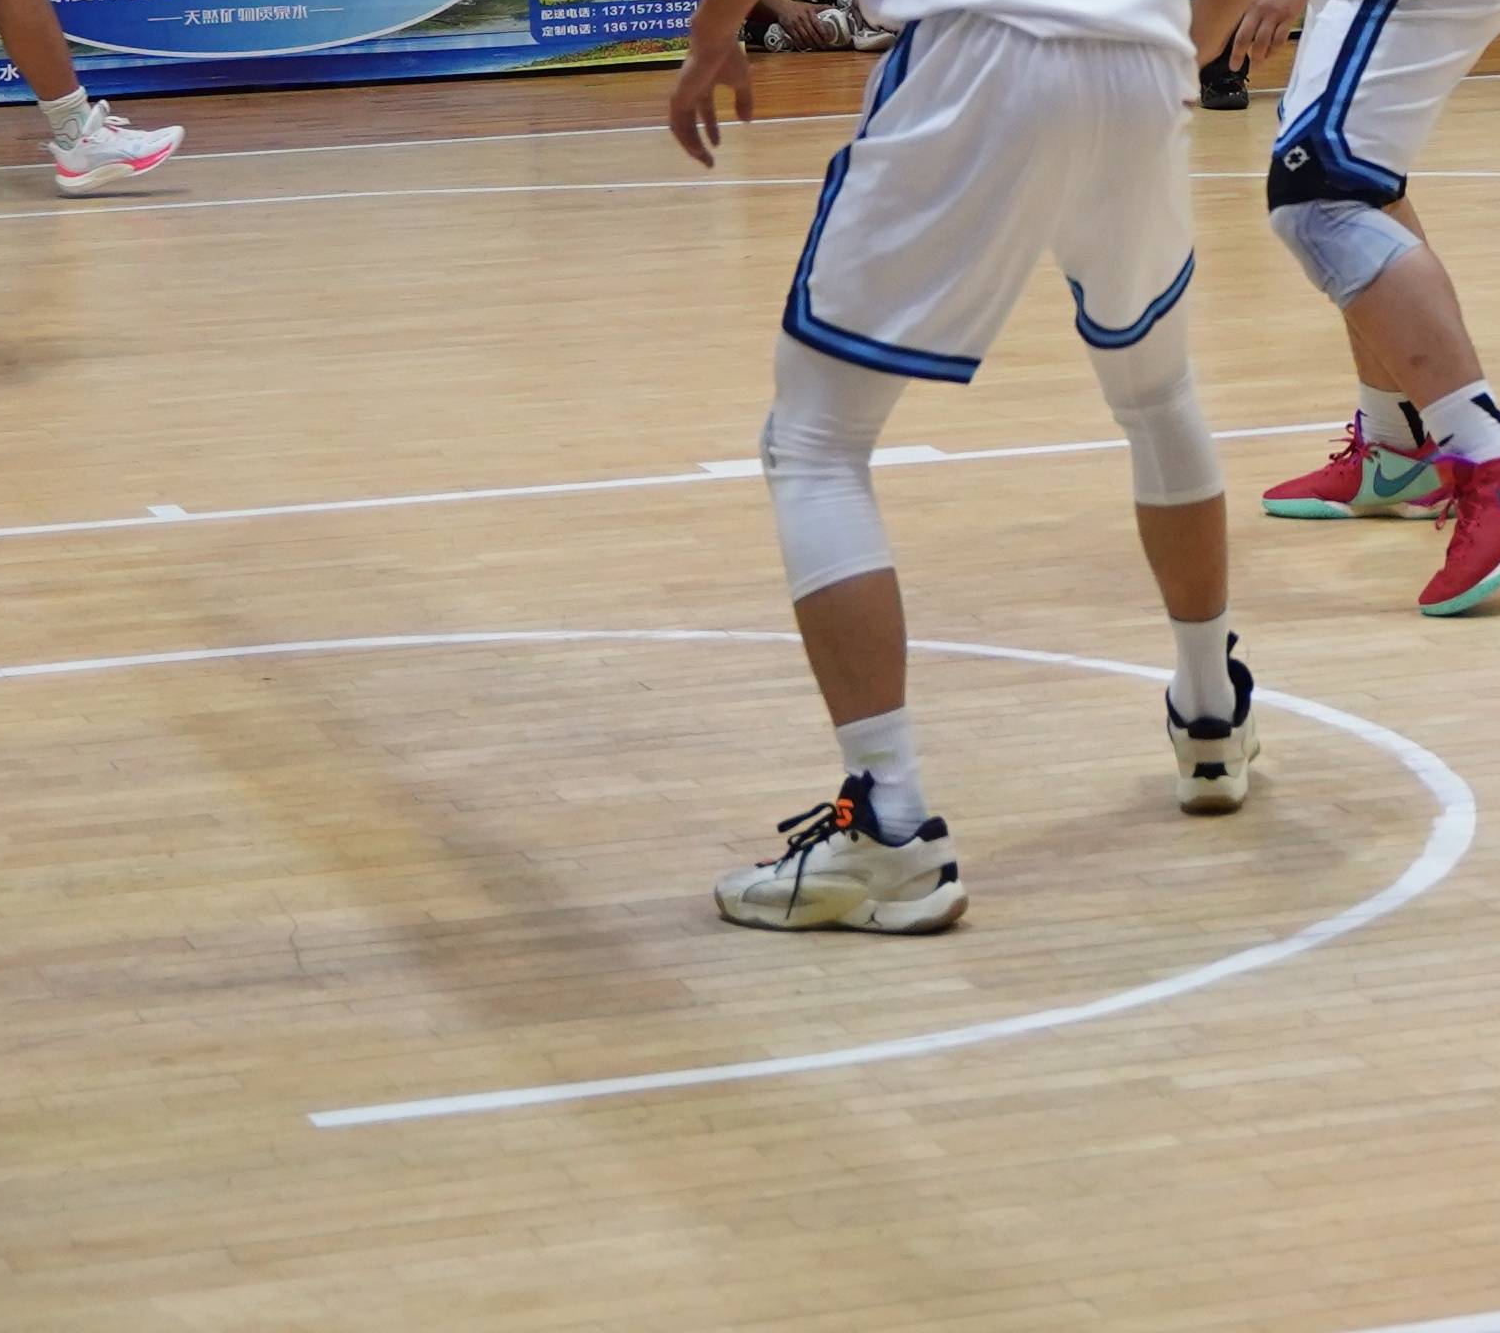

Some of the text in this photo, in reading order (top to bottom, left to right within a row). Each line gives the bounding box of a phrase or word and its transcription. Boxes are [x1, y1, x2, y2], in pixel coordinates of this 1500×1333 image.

[629, 3, 663, 15] 1573
[631, 19, 664, 32] 7071
[666, 18, 693, 30] 585
